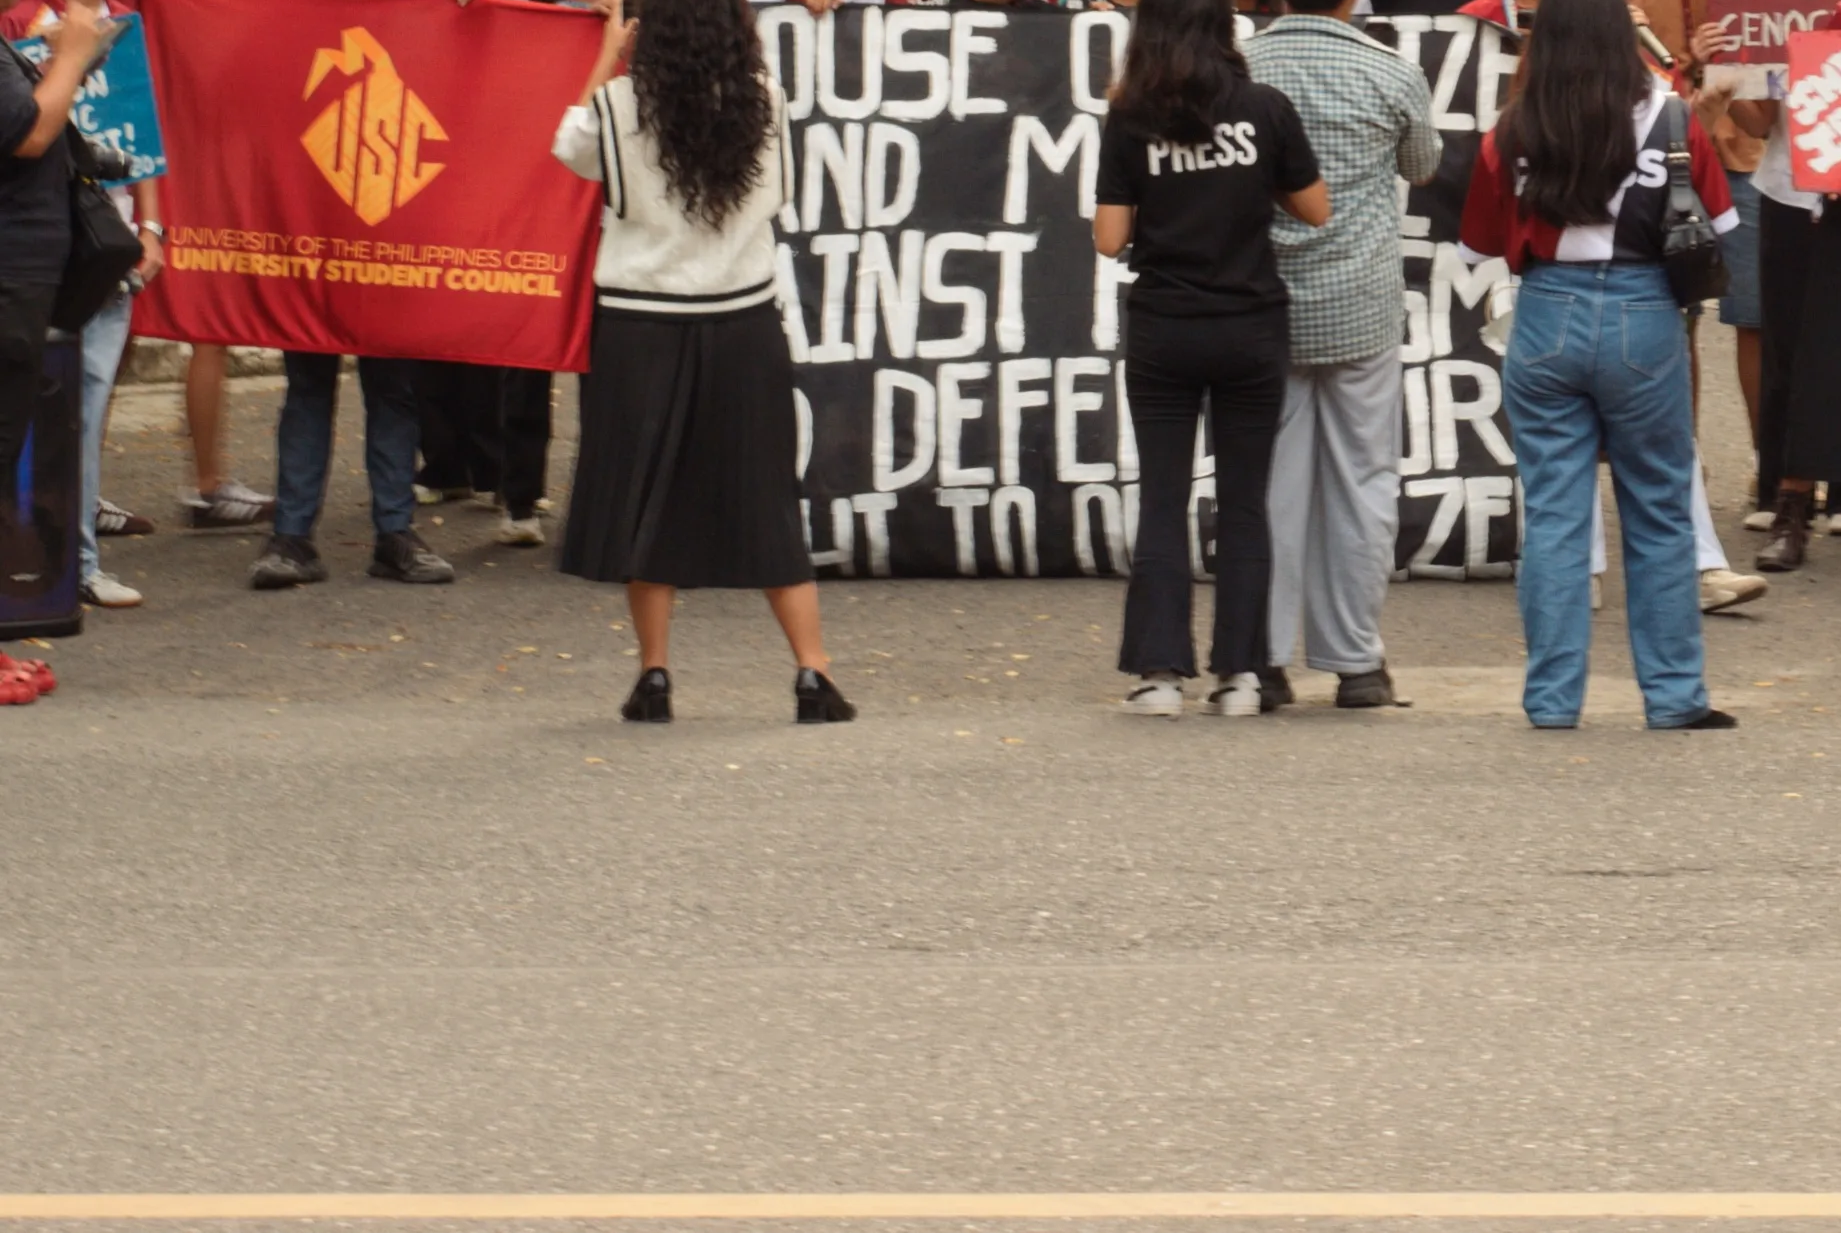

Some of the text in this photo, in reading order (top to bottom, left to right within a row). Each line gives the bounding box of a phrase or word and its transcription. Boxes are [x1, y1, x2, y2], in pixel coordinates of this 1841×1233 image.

[756, 5, 1009, 121] OUSE
[778, 122, 921, 234] ND
[168, 225, 568, 275] UNIVERSITY OF THE PHILIPPINES CEBU
[170, 247, 563, 298] UNIVERSITY STUDENT COUNCIL
[873, 358, 1140, 491] DEFE
